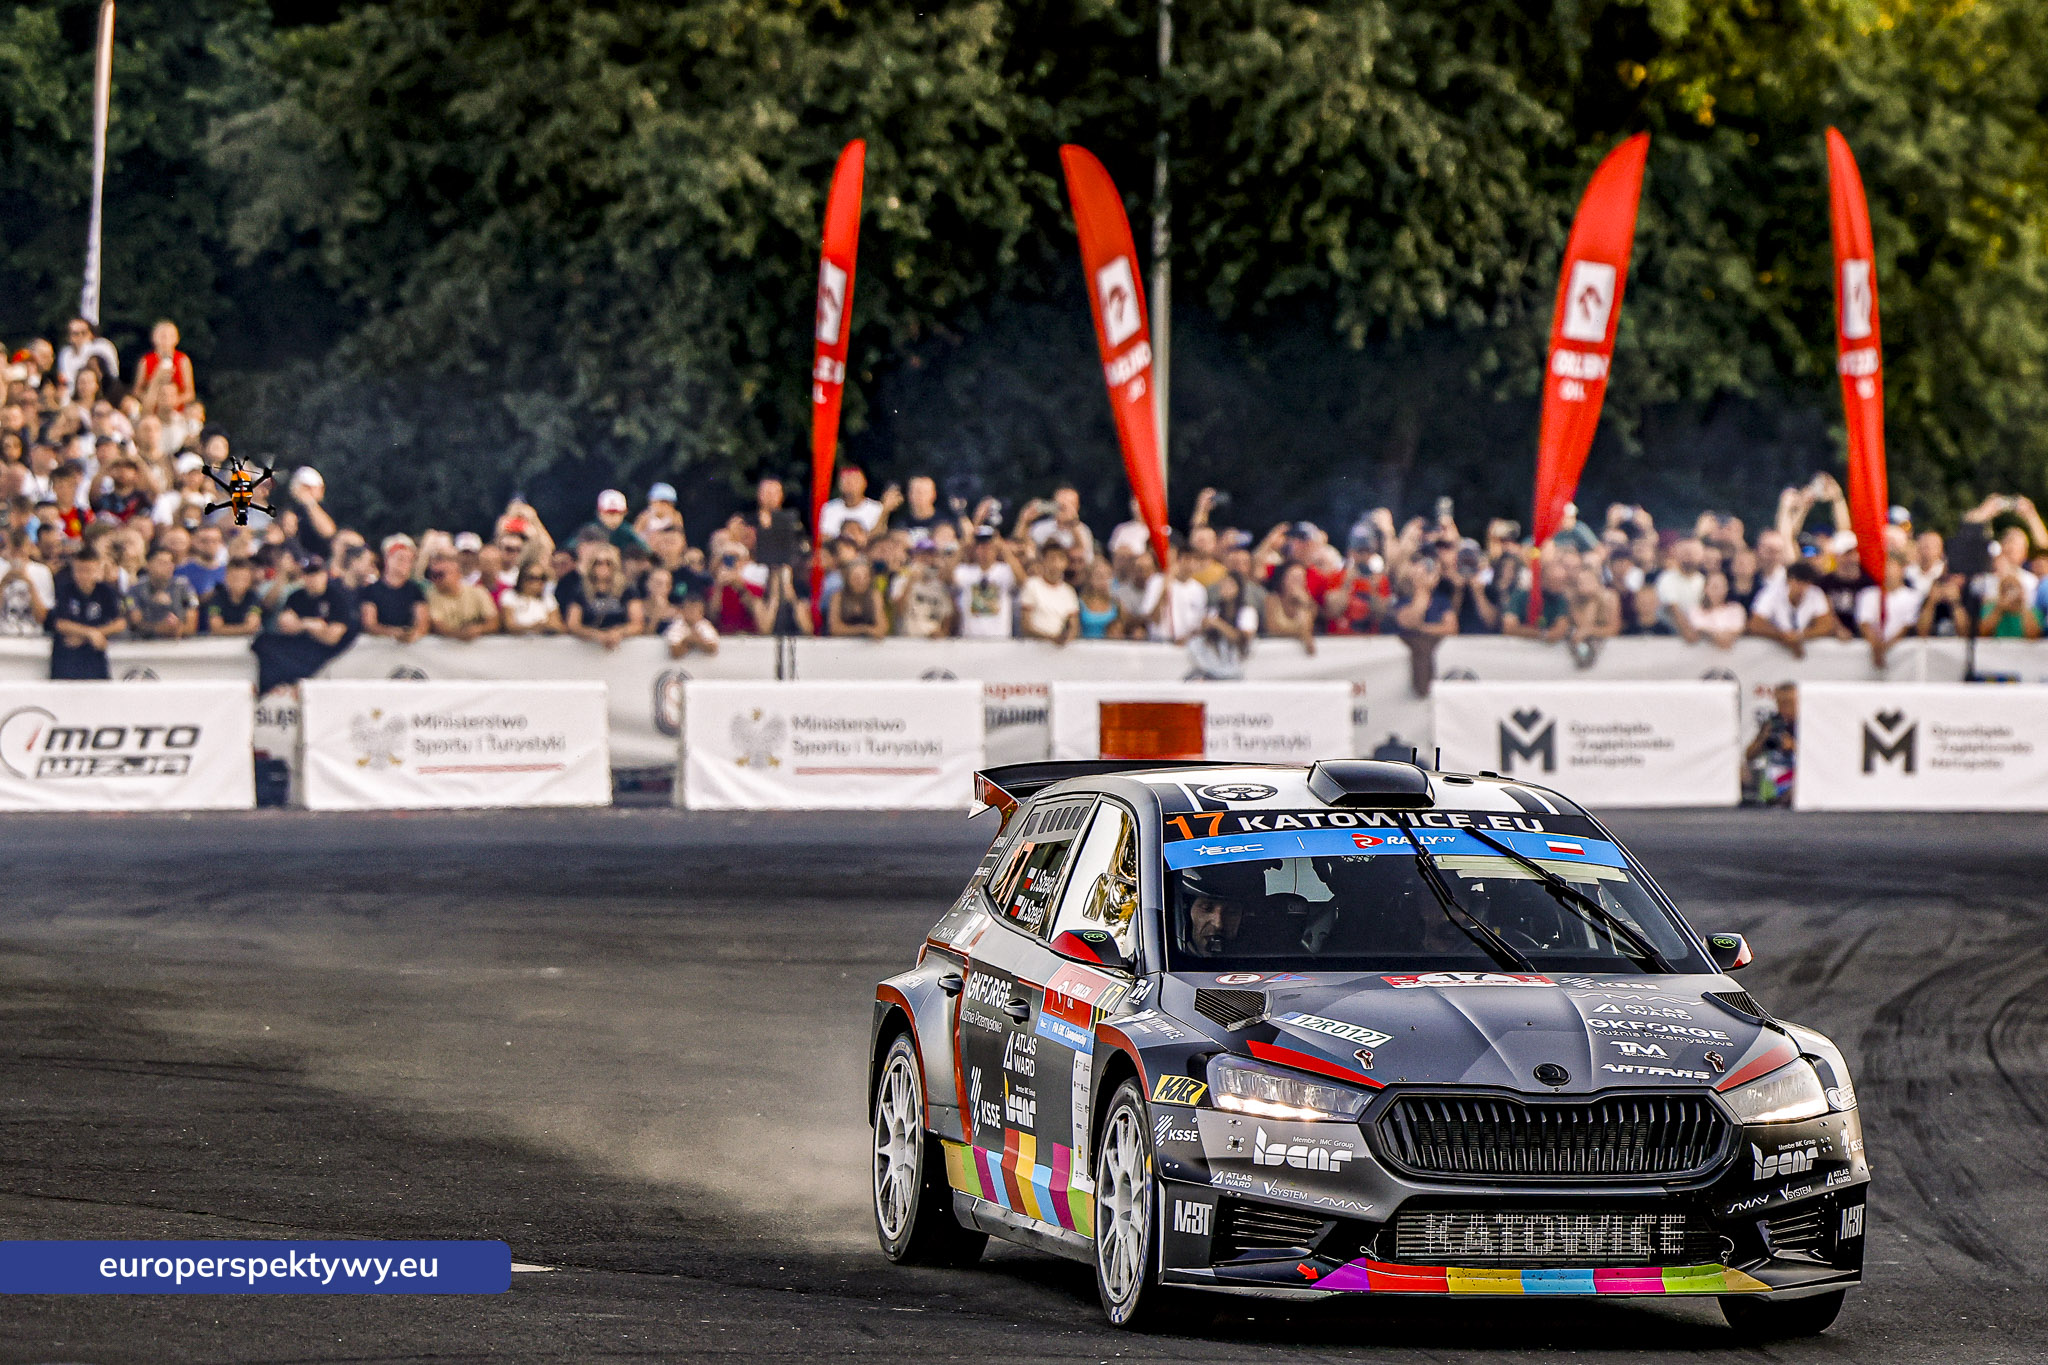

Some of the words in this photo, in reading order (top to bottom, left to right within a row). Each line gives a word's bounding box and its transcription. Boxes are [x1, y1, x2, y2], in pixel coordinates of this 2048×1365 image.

[45, 726, 200, 750] MOTO
[1166, 812, 1225, 840] 17
[1237, 812, 1545, 832] KATOWICE.EU
[967, 970, 1012, 1010] GKFORGE
[1624, 1004, 1690, 1015] ATLAS
[1629, 1008, 1694, 1021] WARD
[1586, 1018, 1732, 1041] GKFORGE
[1594, 1028, 1642, 1038] Kuźnia
[1644, 1031, 1735, 1048] Przemysłowa
[1014, 1032, 1037, 1056] ATLAS
[1013, 1054, 1036, 1077] WARD
[981, 1100, 1001, 1129] KSSE
[1168, 1129, 1199, 1142] KSSE
[1292, 1136, 1317, 1145] Membe
[1319, 1138, 1333, 1146] IMC
[1333, 1140, 1355, 1149] Group
[1225, 1171, 1253, 1182] ATLAS
[1833, 1168, 1850, 1178] ATLAS
[1834, 1176, 1851, 1185] WARD
[1225, 1179, 1252, 1189] WARD
[1414, 1213, 1686, 1255] KATOWICE
